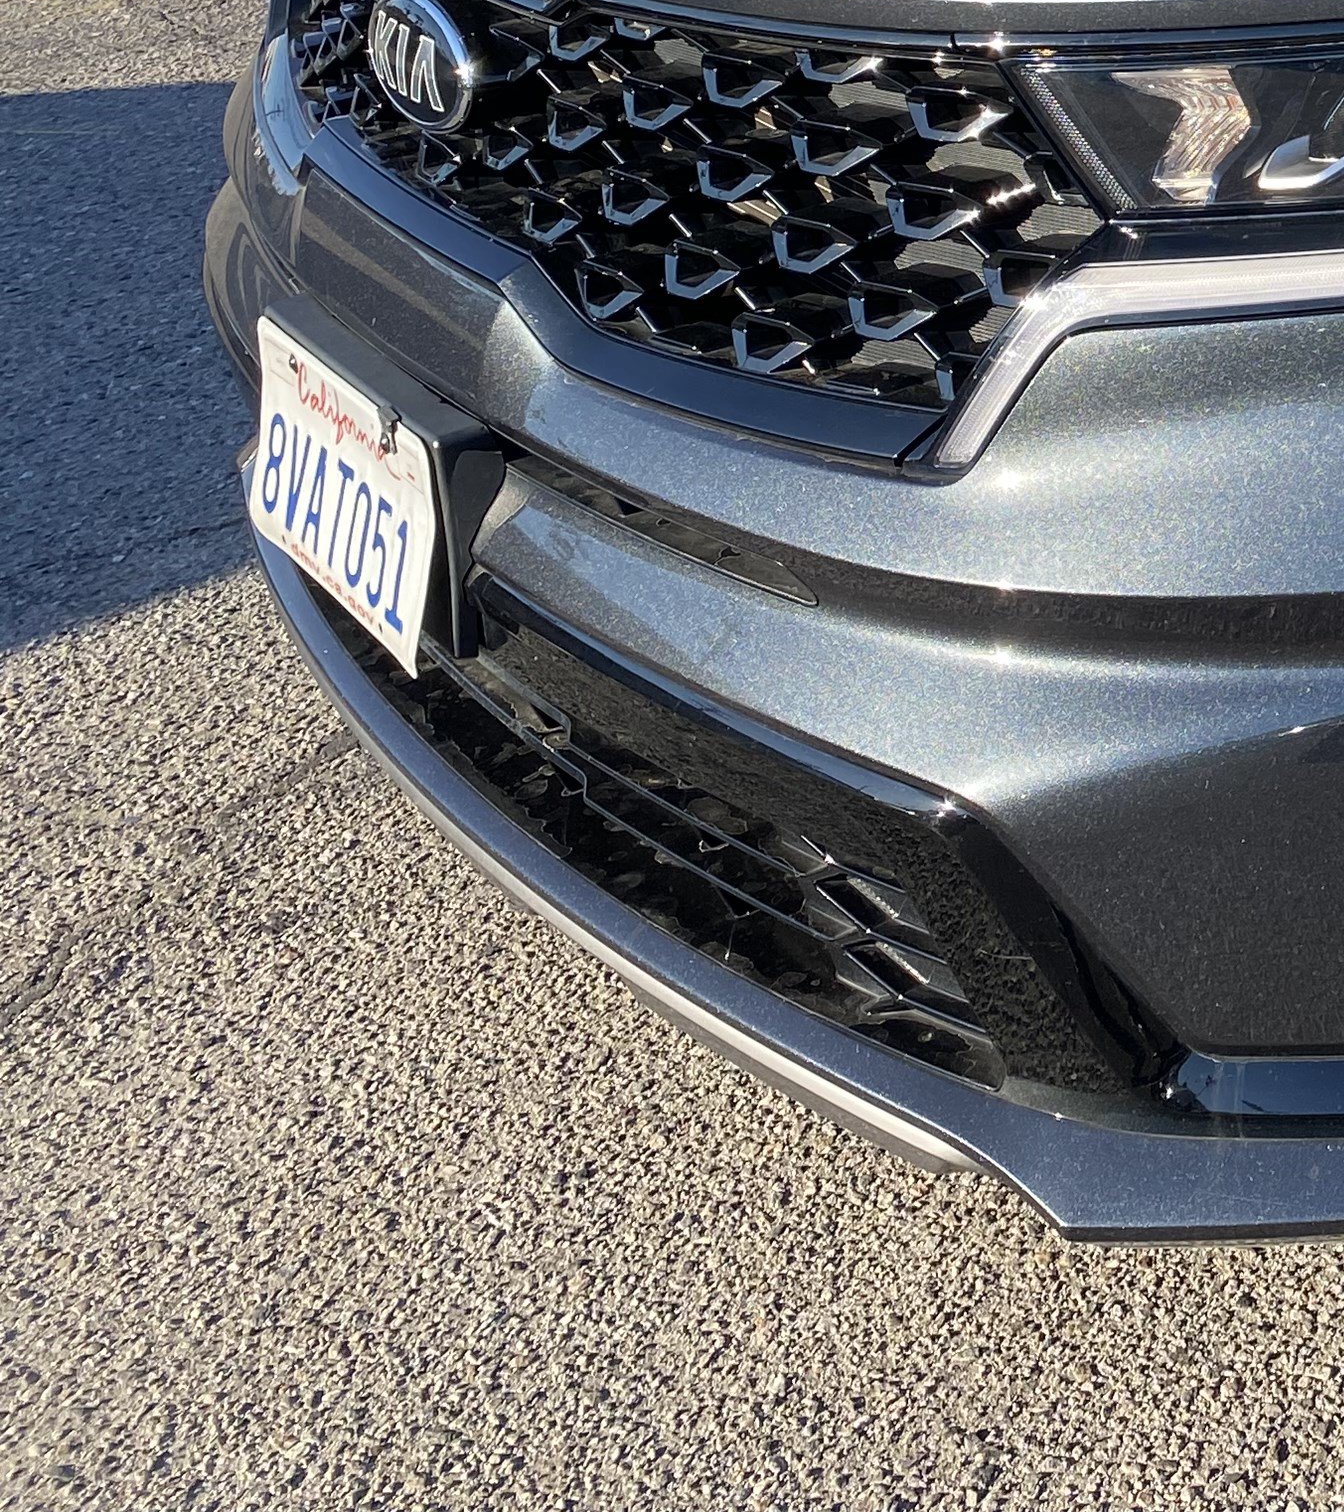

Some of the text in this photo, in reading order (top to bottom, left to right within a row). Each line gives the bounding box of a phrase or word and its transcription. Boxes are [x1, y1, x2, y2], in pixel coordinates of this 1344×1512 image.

[374, 9, 445, 113] KIA
[298, 360, 394, 460] California
[263, 412, 409, 634] 8VAT051
[291, 543, 375, 625] dmv.ca.gov
